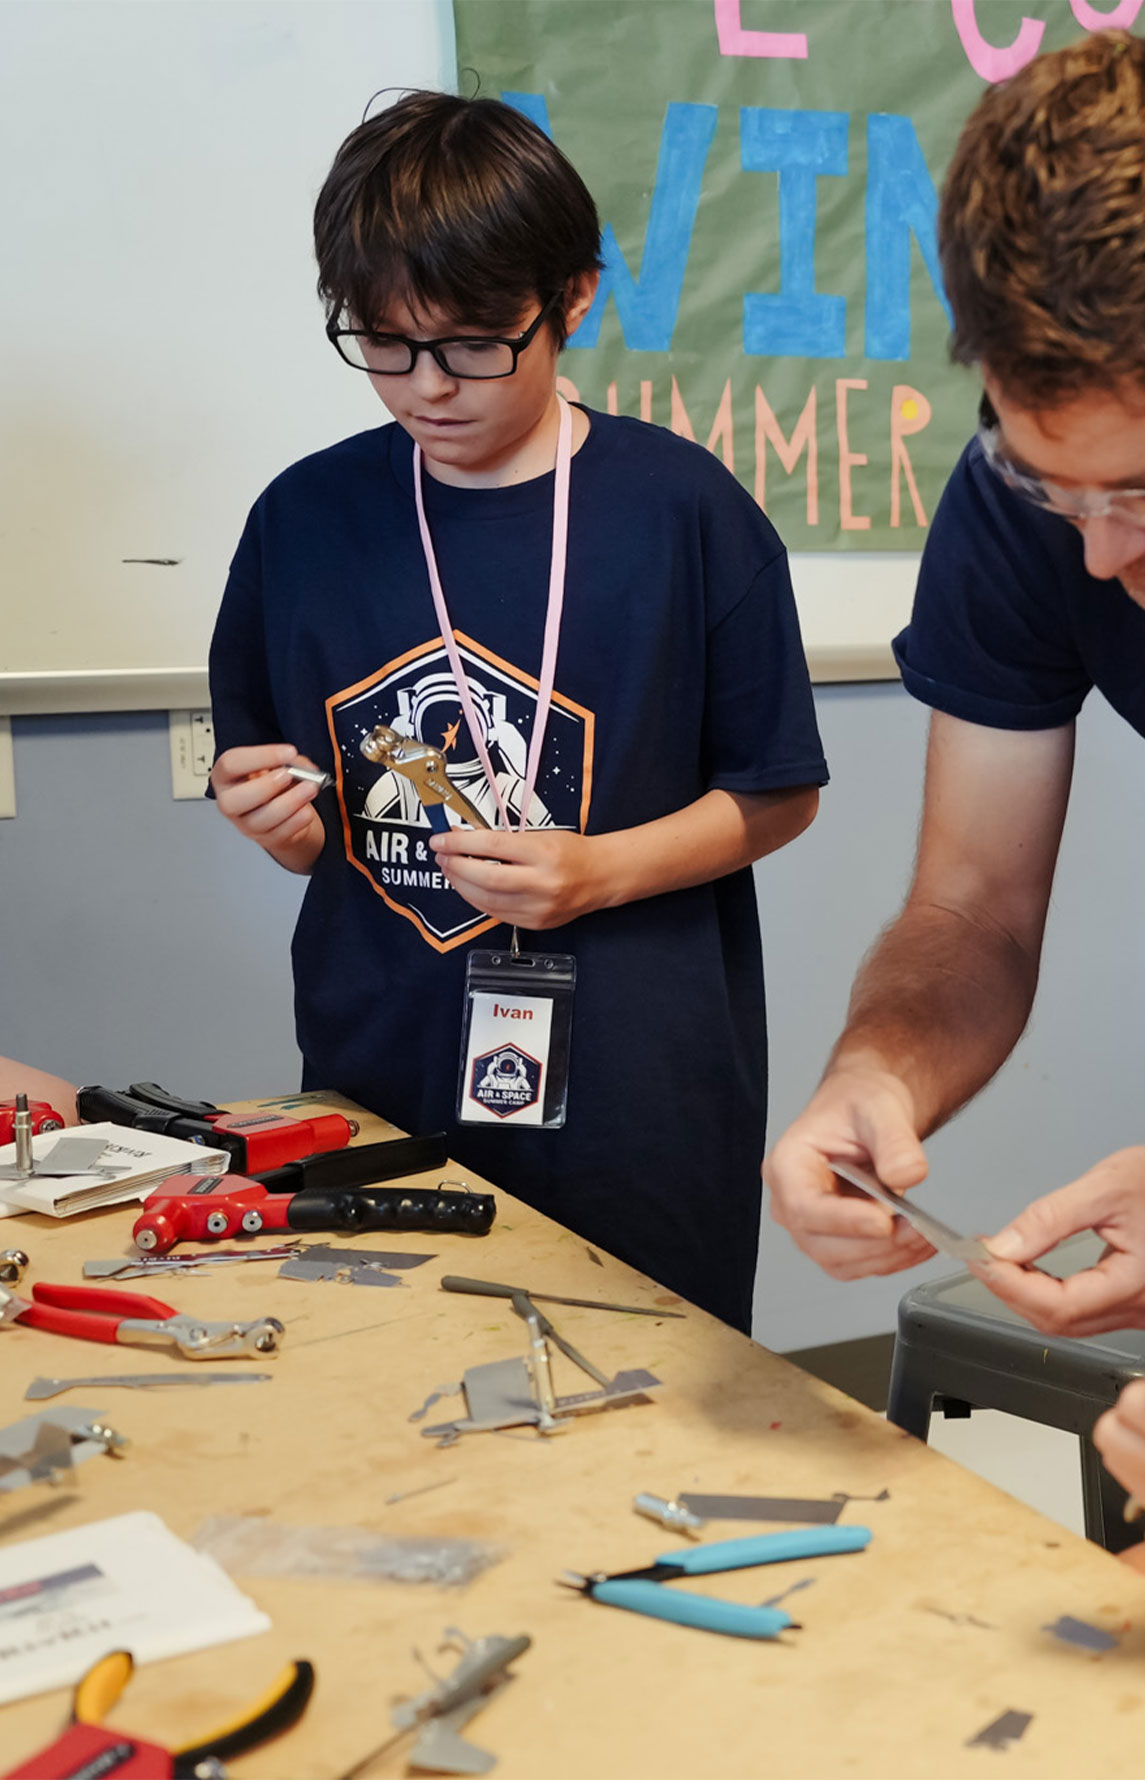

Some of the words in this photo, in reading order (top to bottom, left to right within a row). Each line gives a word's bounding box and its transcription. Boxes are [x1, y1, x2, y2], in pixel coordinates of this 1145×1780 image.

[366, 830, 409, 864] AIR
[415, 841, 428, 861] &
[493, 1003, 534, 1020] Ivan
[477, 1089, 494, 1098] AIR
[501, 1090, 532, 1101] SPACE
